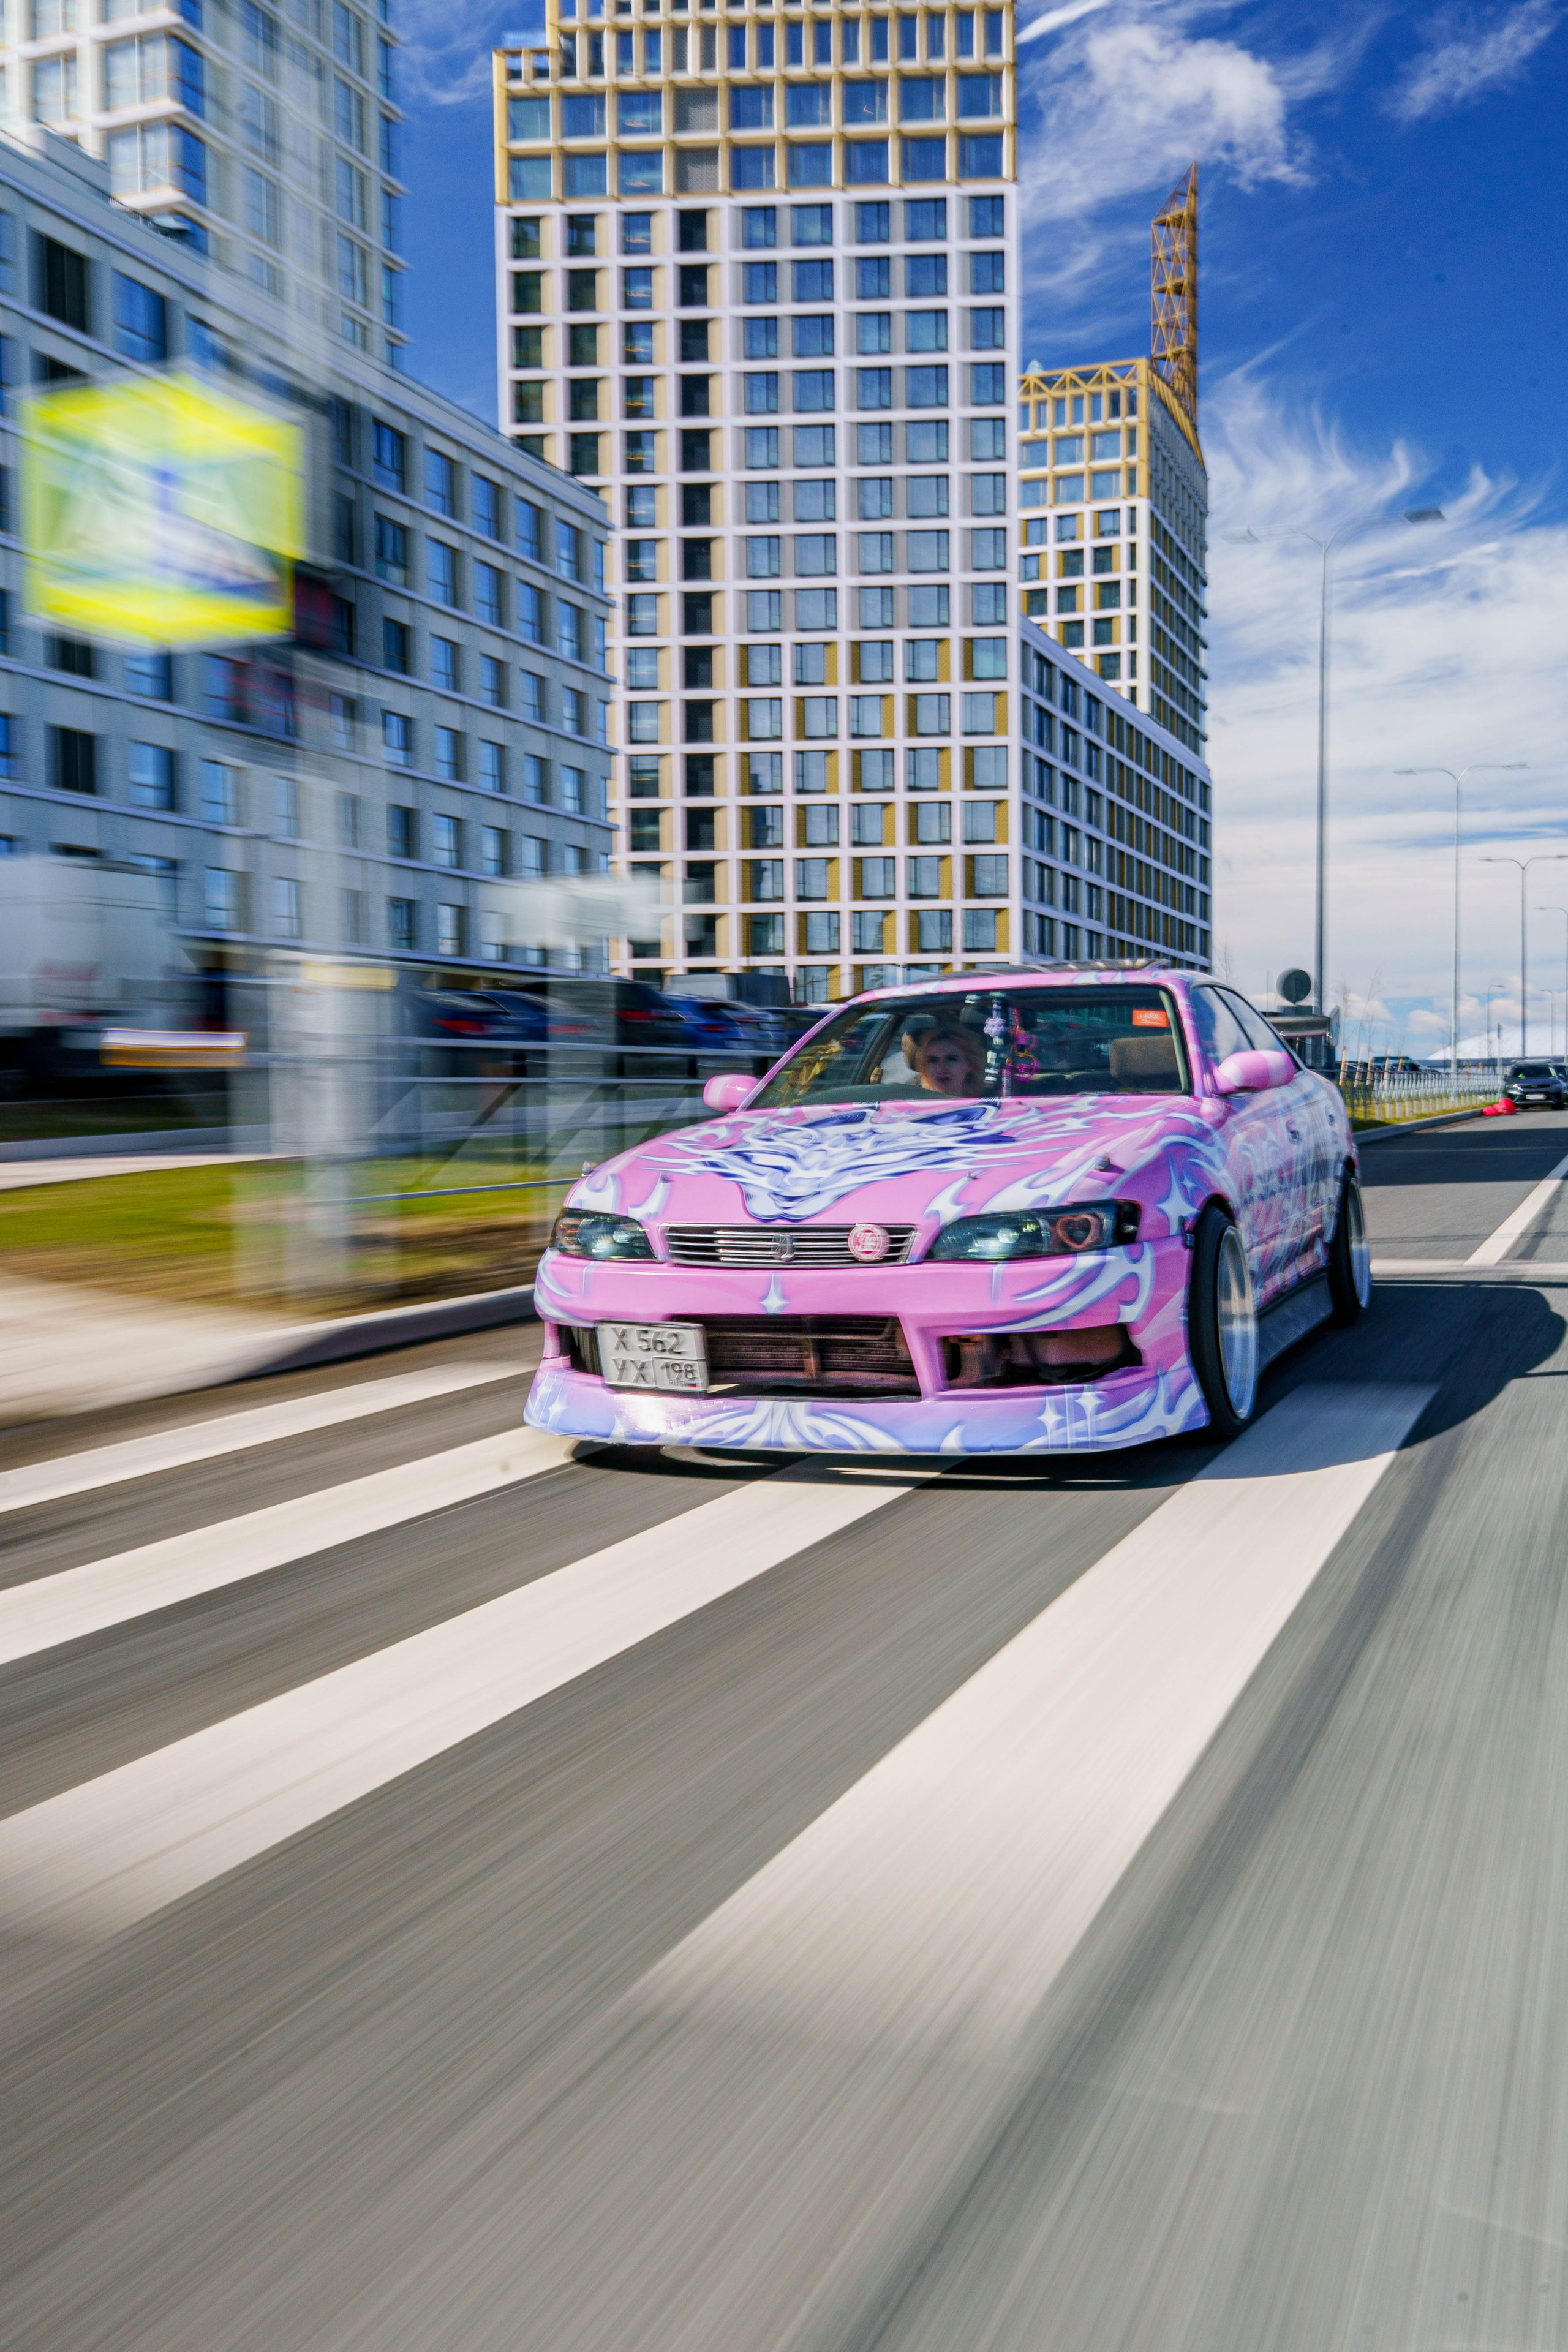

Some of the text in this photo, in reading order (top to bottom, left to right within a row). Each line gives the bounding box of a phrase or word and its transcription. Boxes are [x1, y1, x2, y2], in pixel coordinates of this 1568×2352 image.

[612, 1327, 684, 1354] X 562
[660, 1361, 696, 1381] 198
